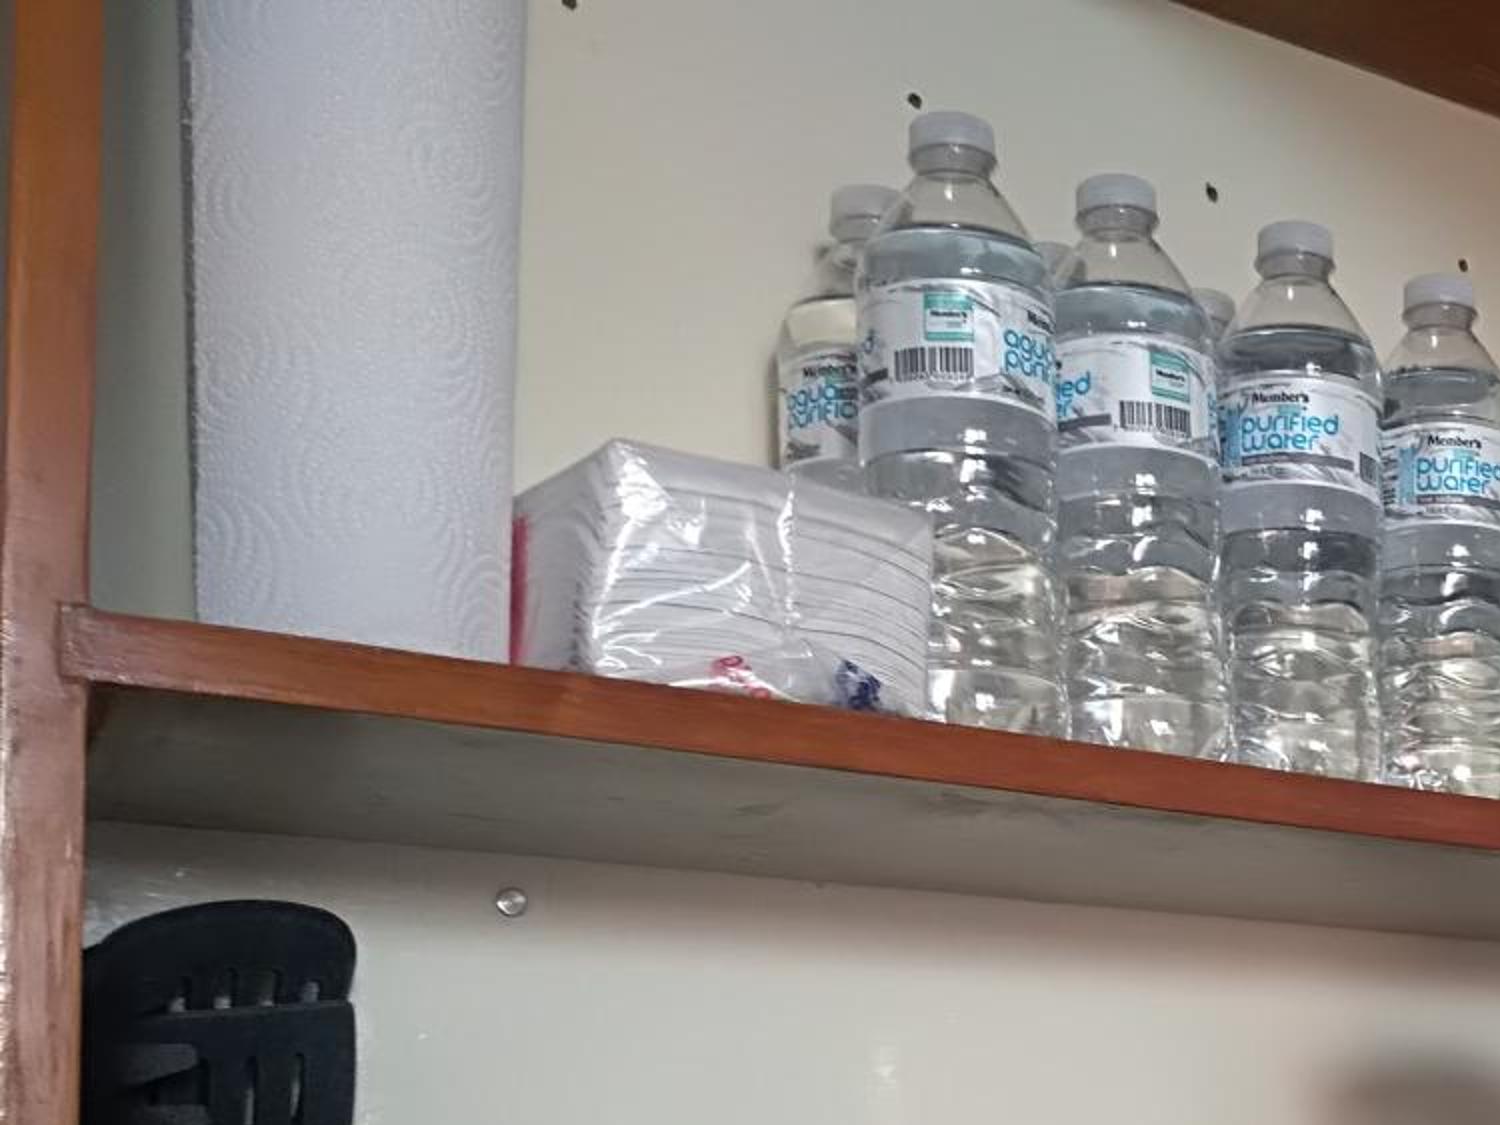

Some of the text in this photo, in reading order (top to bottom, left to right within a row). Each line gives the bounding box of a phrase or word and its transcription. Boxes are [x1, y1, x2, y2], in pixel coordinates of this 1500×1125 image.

[1241, 413, 1340, 436] purified
[1241, 432, 1320, 452] water
[1416, 475, 1491, 494] water
